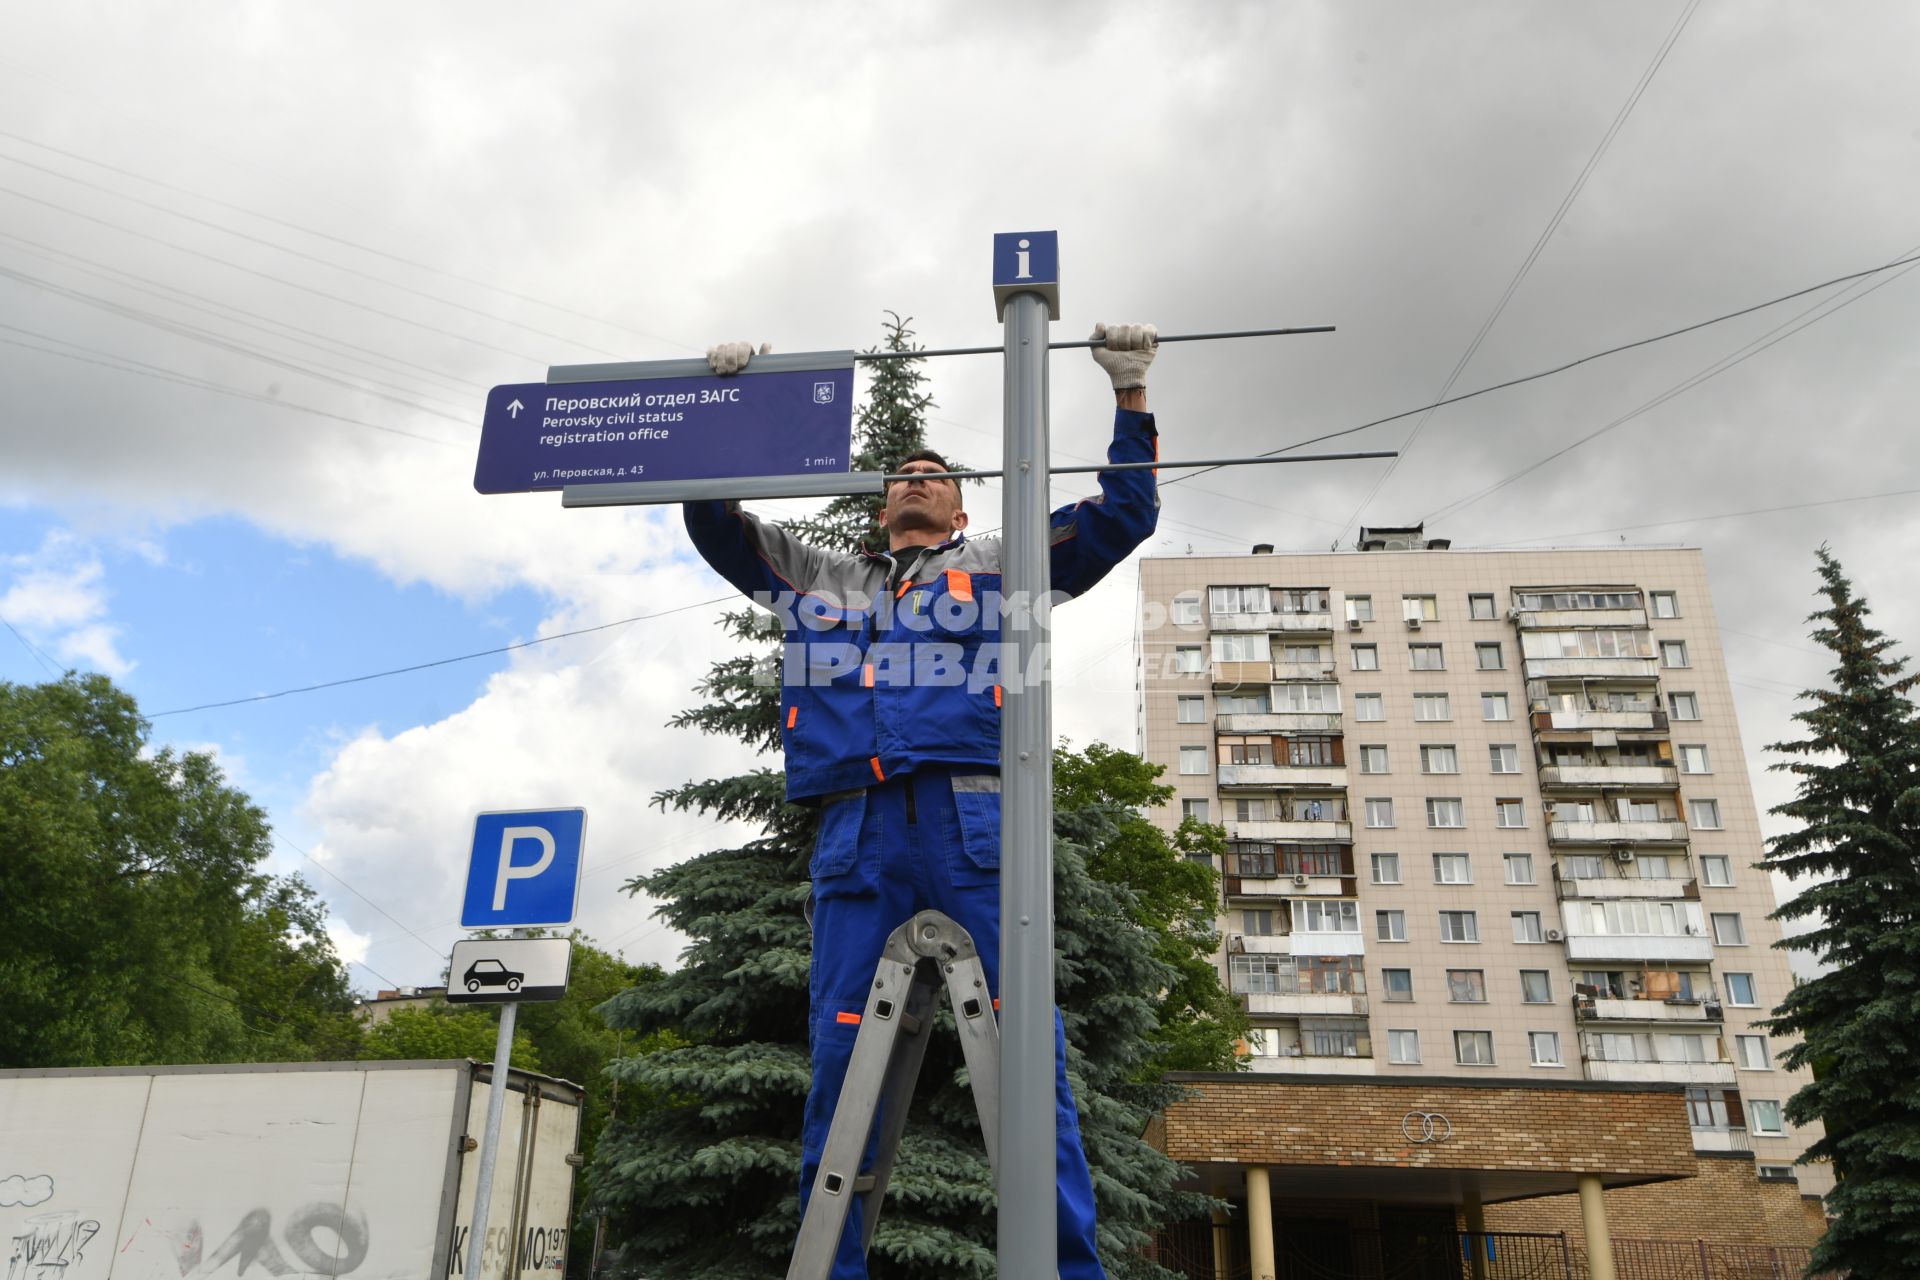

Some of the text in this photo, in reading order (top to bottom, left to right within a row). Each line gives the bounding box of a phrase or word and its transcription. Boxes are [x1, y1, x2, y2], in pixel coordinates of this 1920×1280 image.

[1015, 239, 1033, 279] i
[545, 388, 740, 413] Перовский отдел ЗАГС
[542, 411, 684, 428] Perovsky civil status
[540, 428, 669, 447] registration office
[804, 456, 836, 467] 1 min
[532, 465, 644, 481] ул. Перовская, д. 43
[491, 825, 556, 911] P
[547, 1227, 567, 1251] 197
